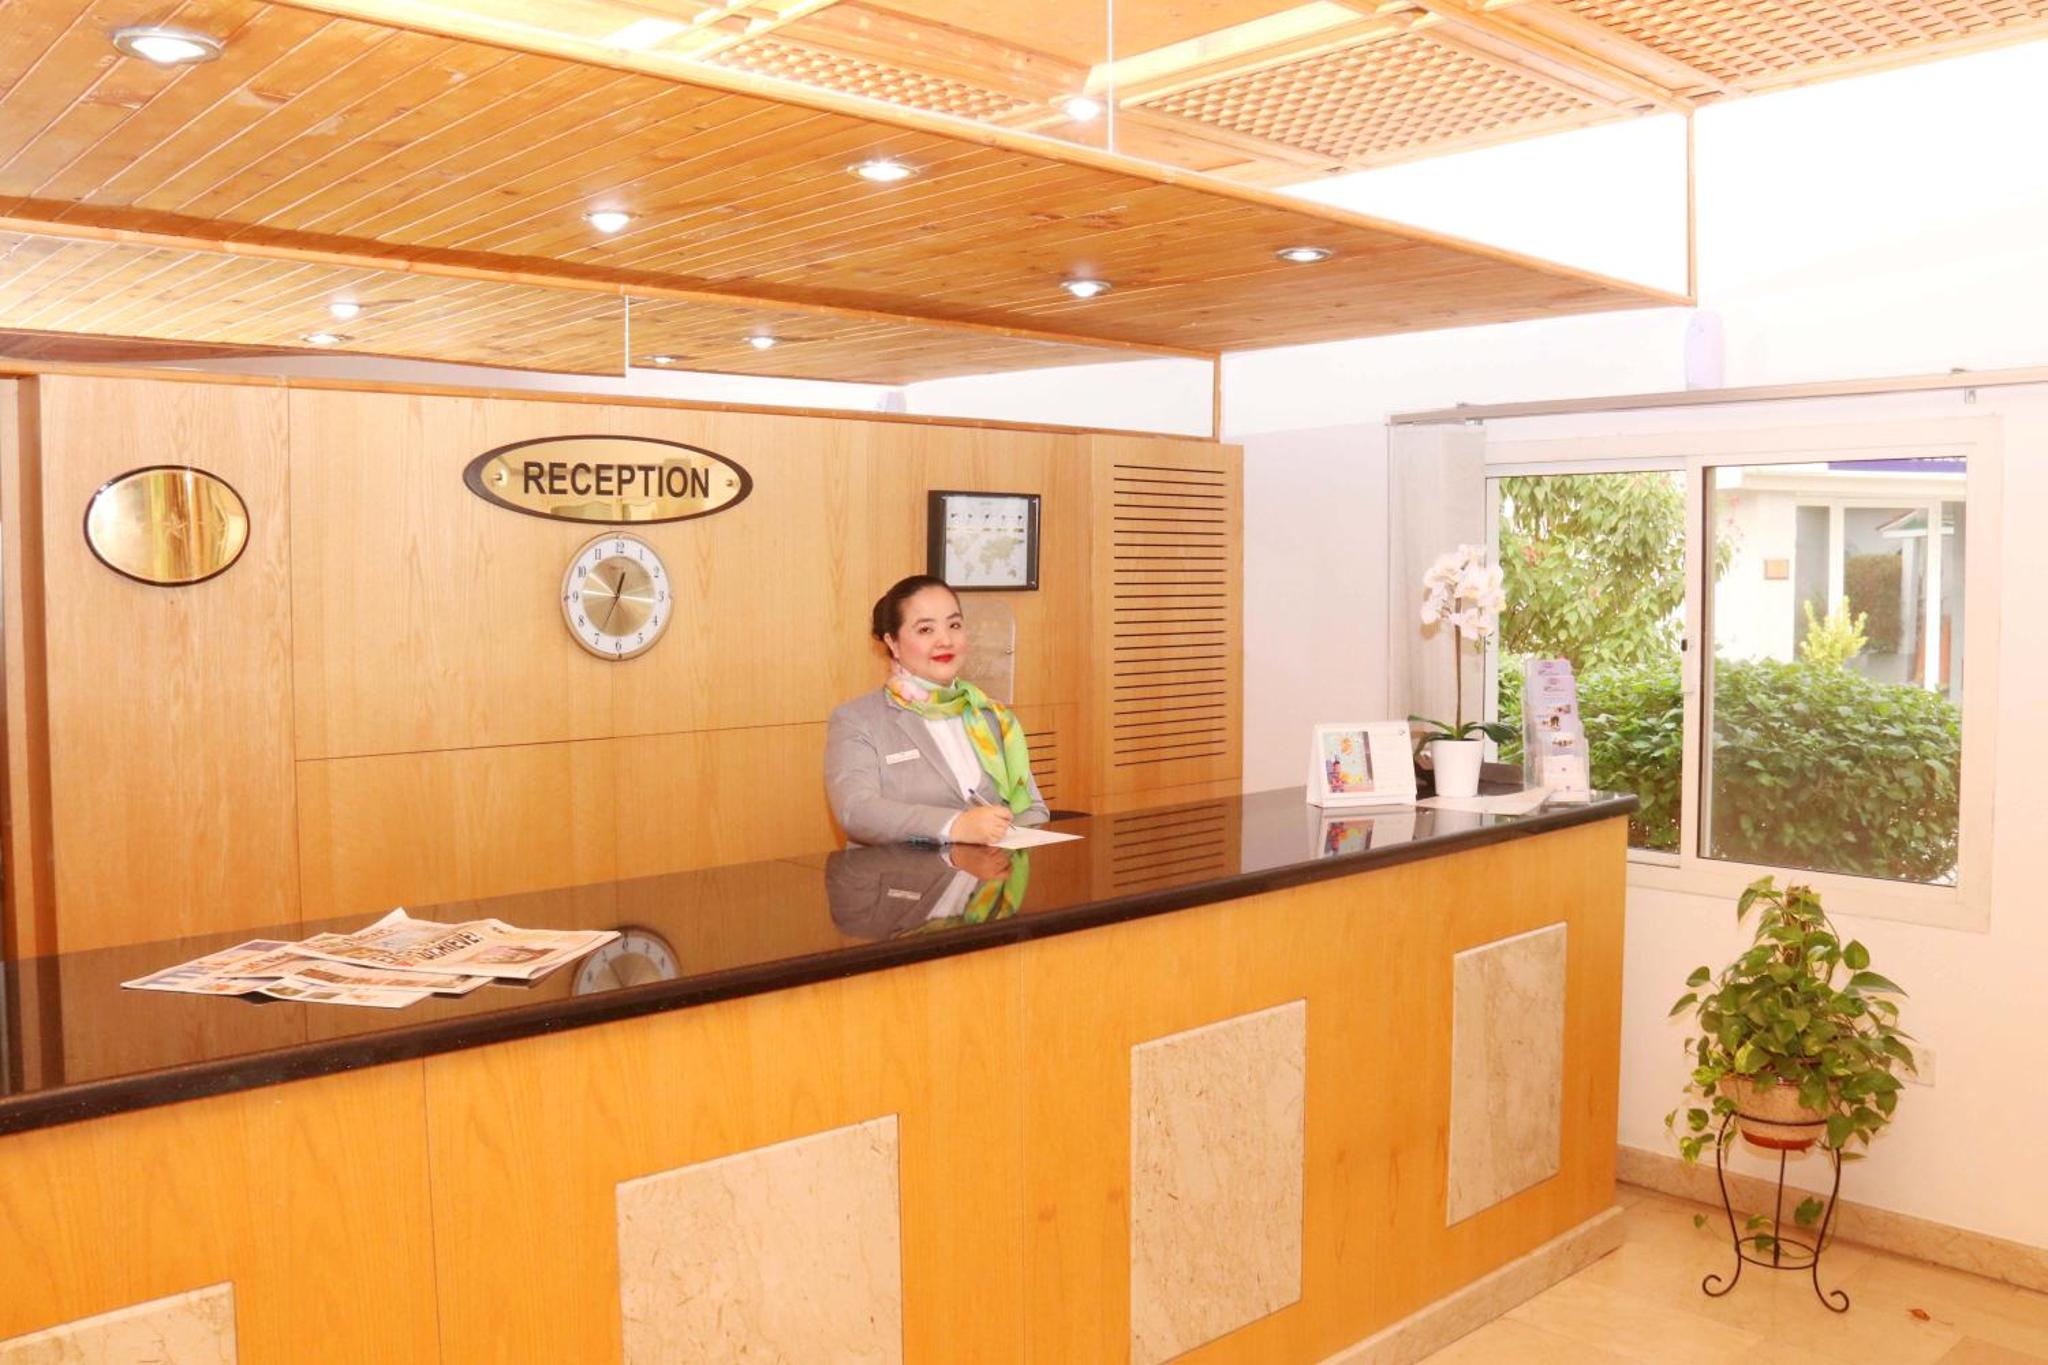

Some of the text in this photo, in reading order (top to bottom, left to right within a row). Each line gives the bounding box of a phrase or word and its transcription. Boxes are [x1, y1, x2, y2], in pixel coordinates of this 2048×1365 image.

[523, 460, 709, 499] RECEPTION
[615, 541, 625, 554] 12
[594, 548, 602, 560] 11
[578, 566, 587, 578] 10
[653, 566, 660, 578] 2
[572, 591, 579, 603] 9
[658, 590, 665, 602] 3
[578, 615, 585, 627] 8
[650, 615, 658, 626] 4
[594, 632, 600, 645] 7
[637, 632, 644, 644] 5
[615, 638, 622, 651] 6
